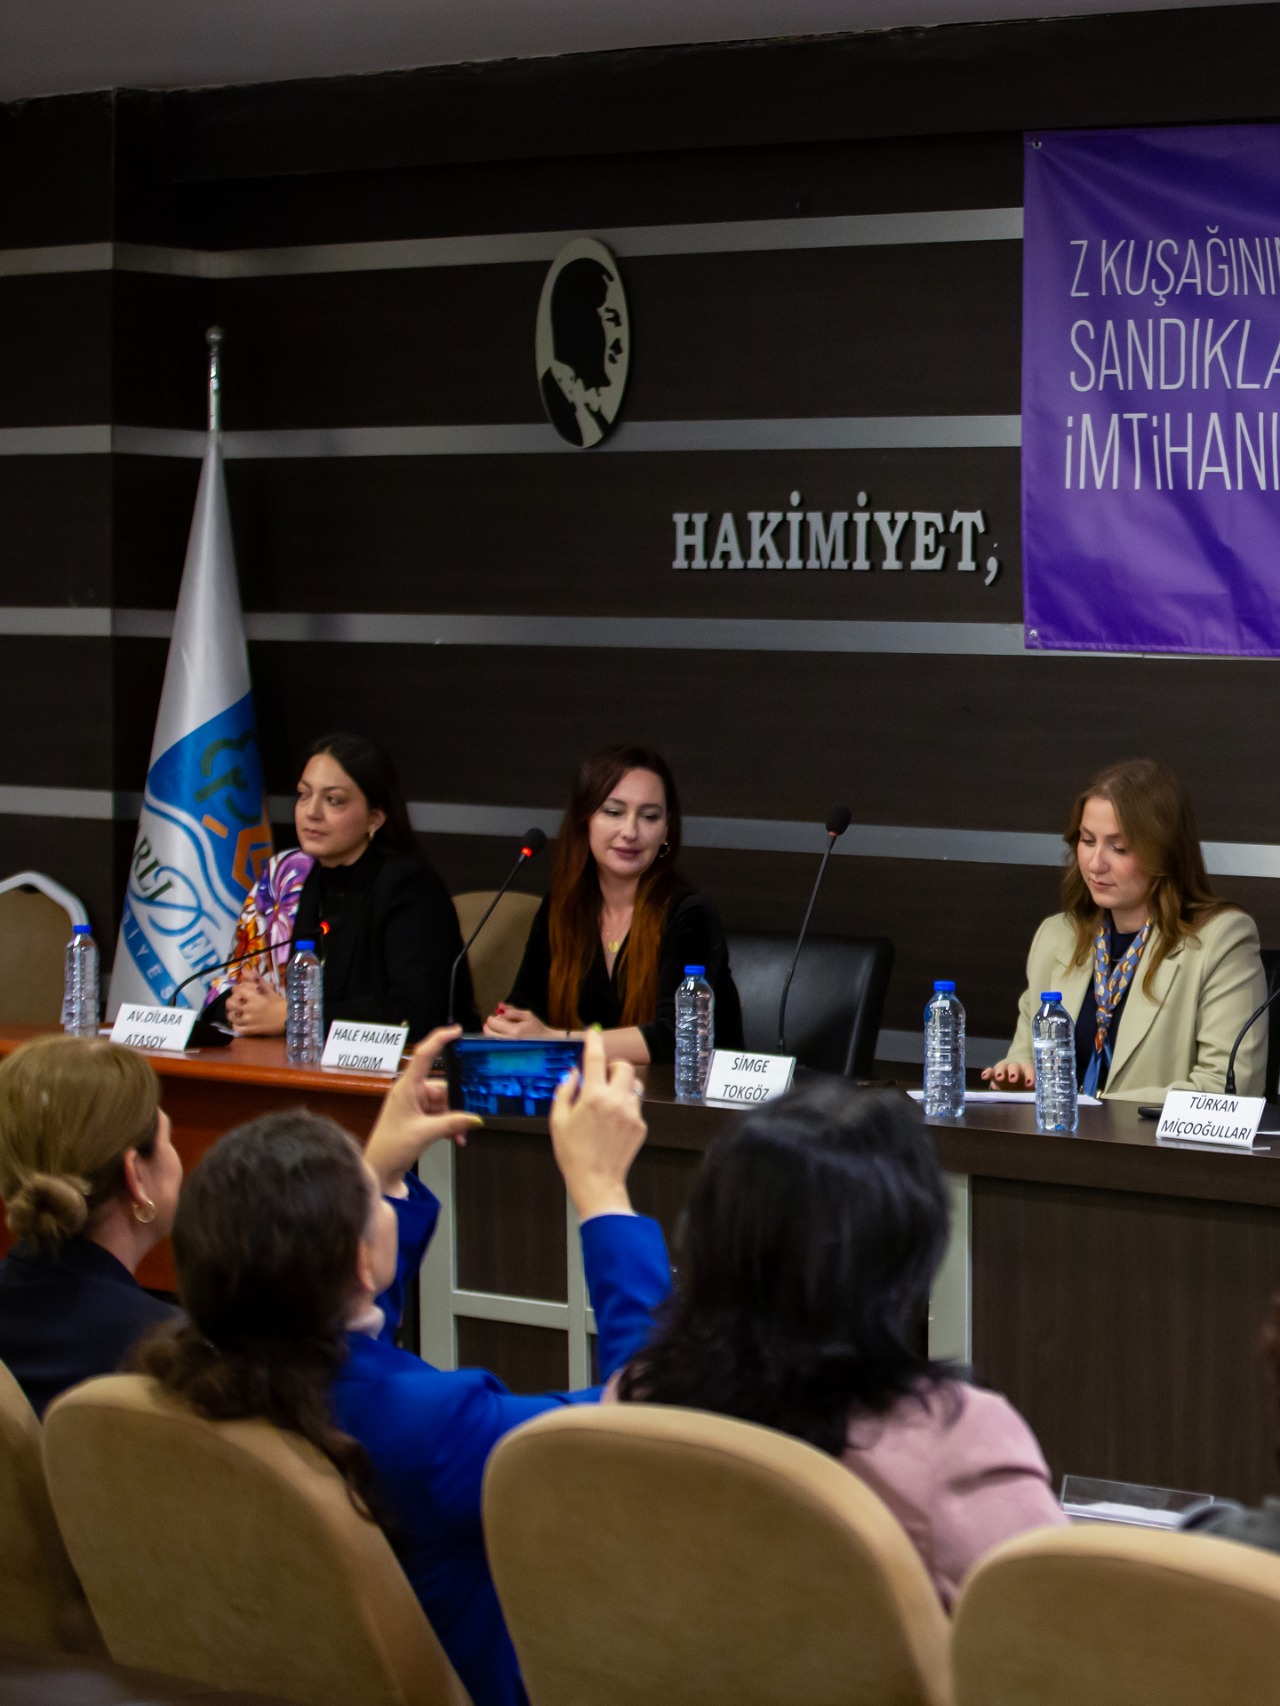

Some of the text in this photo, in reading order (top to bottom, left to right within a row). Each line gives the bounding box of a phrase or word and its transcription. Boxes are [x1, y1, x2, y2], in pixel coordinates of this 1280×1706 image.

[1070, 239, 1090, 298] Z
[126, 1010, 183, 1027] AV.DİLARA
[123, 1034, 167, 1049] ATASOY
[332, 1028, 403, 1046] HALE HALİME
[336, 1053, 384, 1070] YILDIRIM
[731, 1055, 770, 1073] SİMGE
[722, 1084, 770, 1101] TOKGÖZ
[1189, 1094, 1239, 1113] TÜRKAN
[1160, 1118, 1252, 1141] MİÇOOĞULLARI
